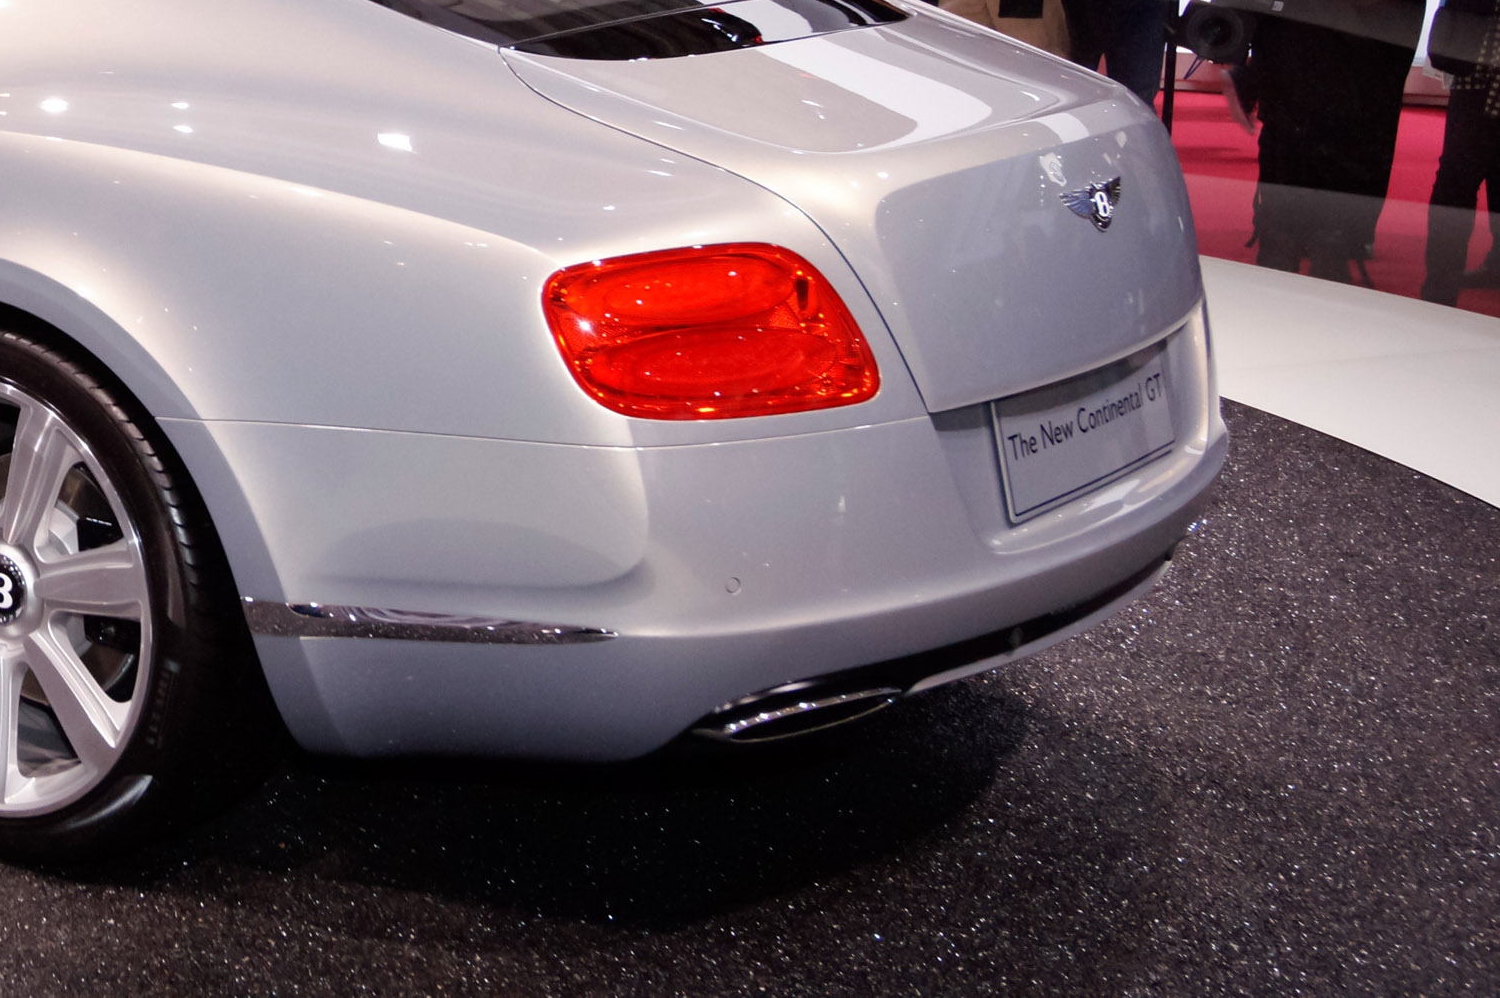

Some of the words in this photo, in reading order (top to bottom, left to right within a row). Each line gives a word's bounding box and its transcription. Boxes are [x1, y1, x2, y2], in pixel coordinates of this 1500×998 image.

[1007, 433, 1037, 461] The
[1039, 420, 1074, 449] New
[1076, 382, 1143, 433] Continental
[1145, 373, 1161, 402] GT
